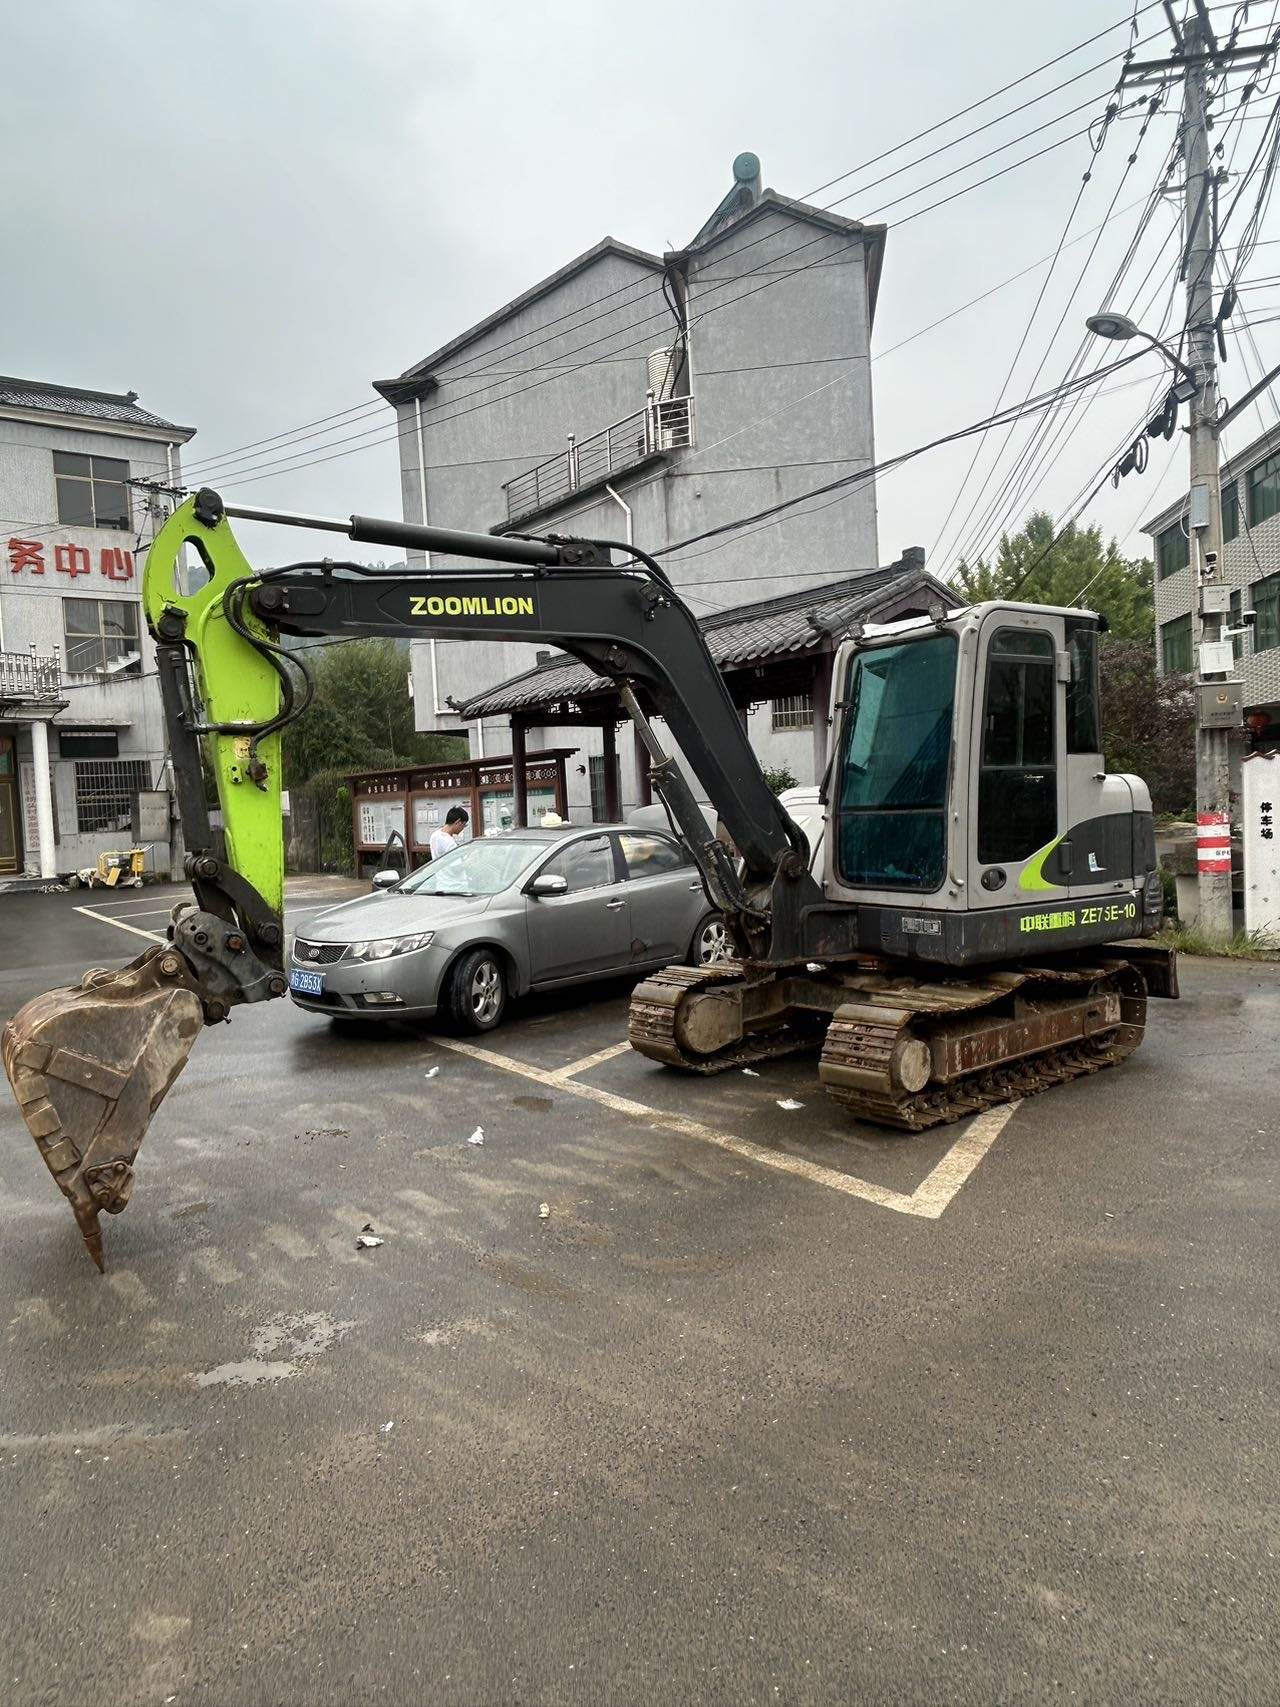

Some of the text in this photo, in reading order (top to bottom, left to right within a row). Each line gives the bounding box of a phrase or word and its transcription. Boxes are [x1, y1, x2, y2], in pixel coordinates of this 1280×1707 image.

[8, 537, 134, 580] 务中心
[409, 596, 534, 615] ZOOMLION
[1080, 903, 1136, 925] ZE75E-10
